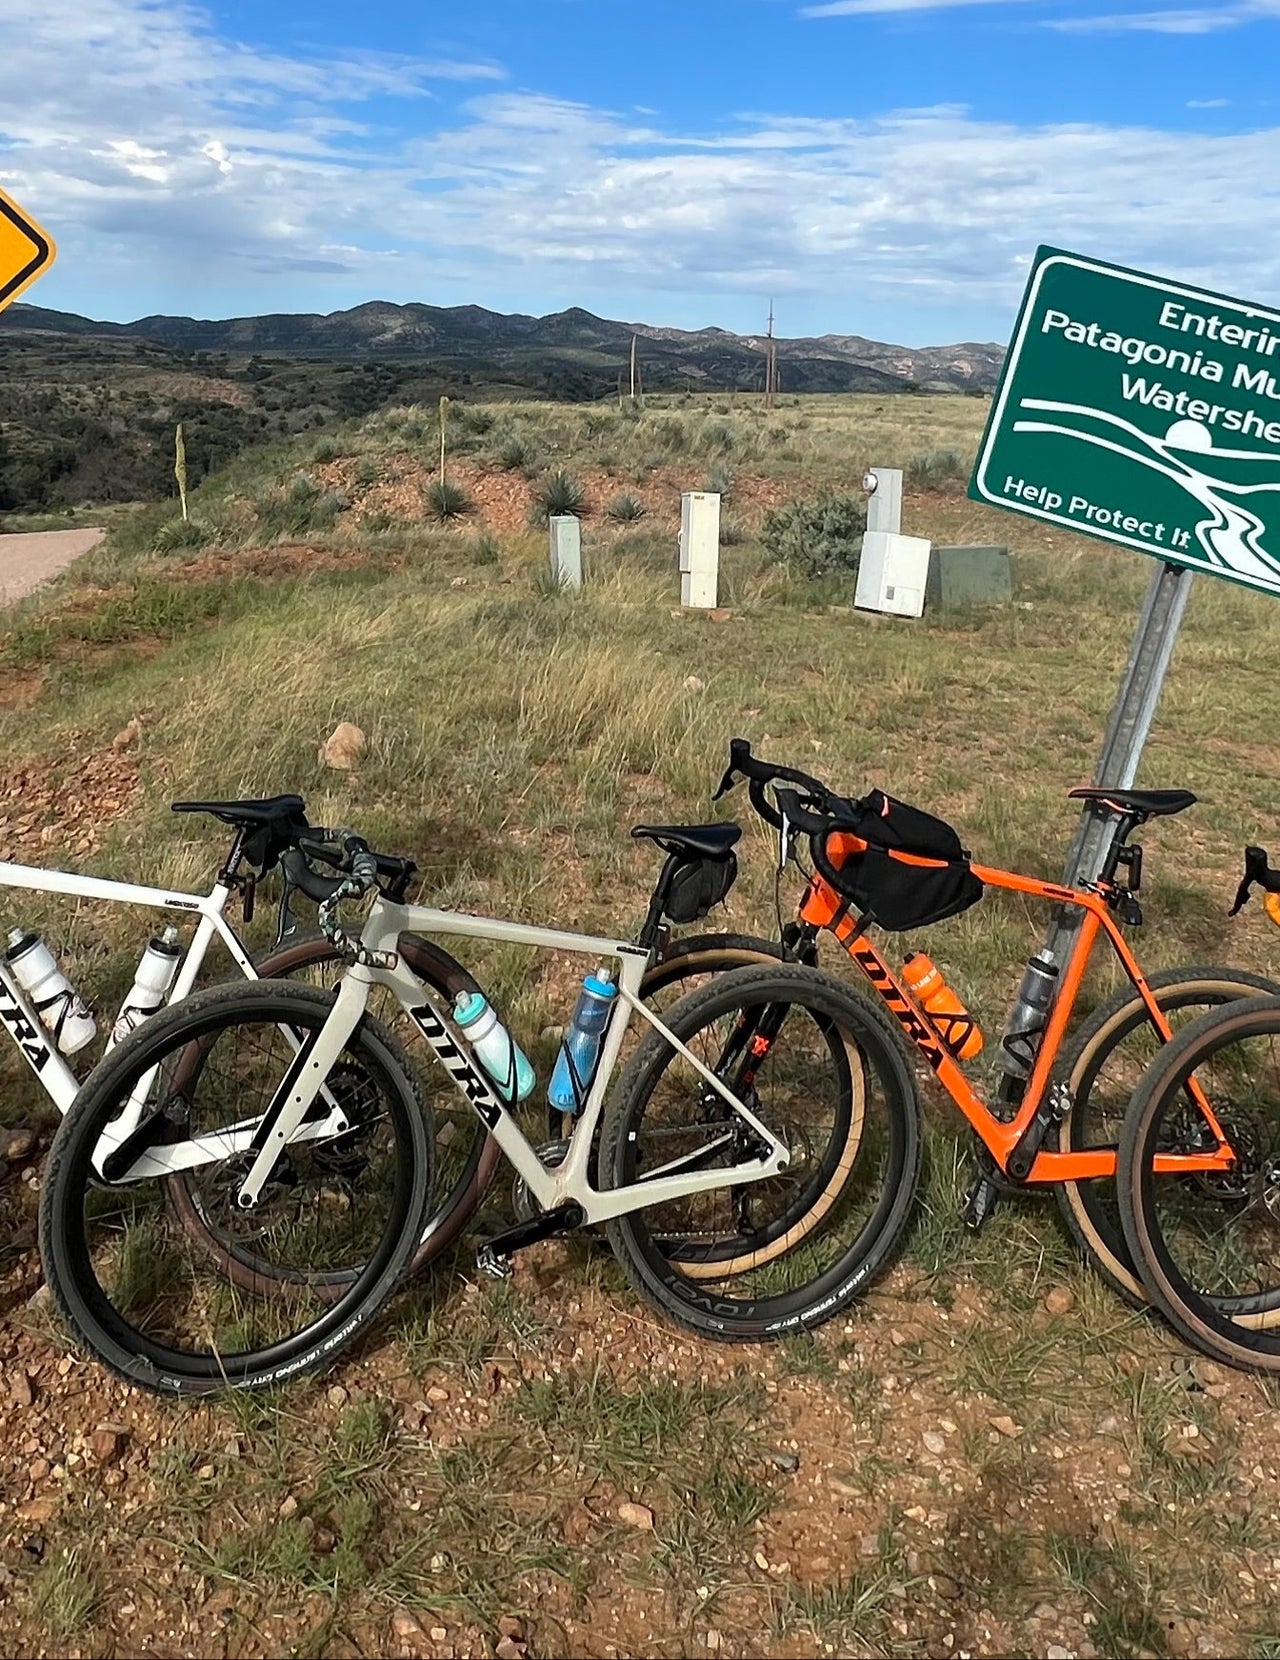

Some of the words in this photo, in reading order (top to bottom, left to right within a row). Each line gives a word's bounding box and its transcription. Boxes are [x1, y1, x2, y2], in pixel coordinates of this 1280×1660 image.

[1041, 309, 1224, 383] Patagonia
[1004, 475, 1062, 511] Help
[1069, 495, 1165, 543] Protect
[1171, 527, 1190, 549] It
